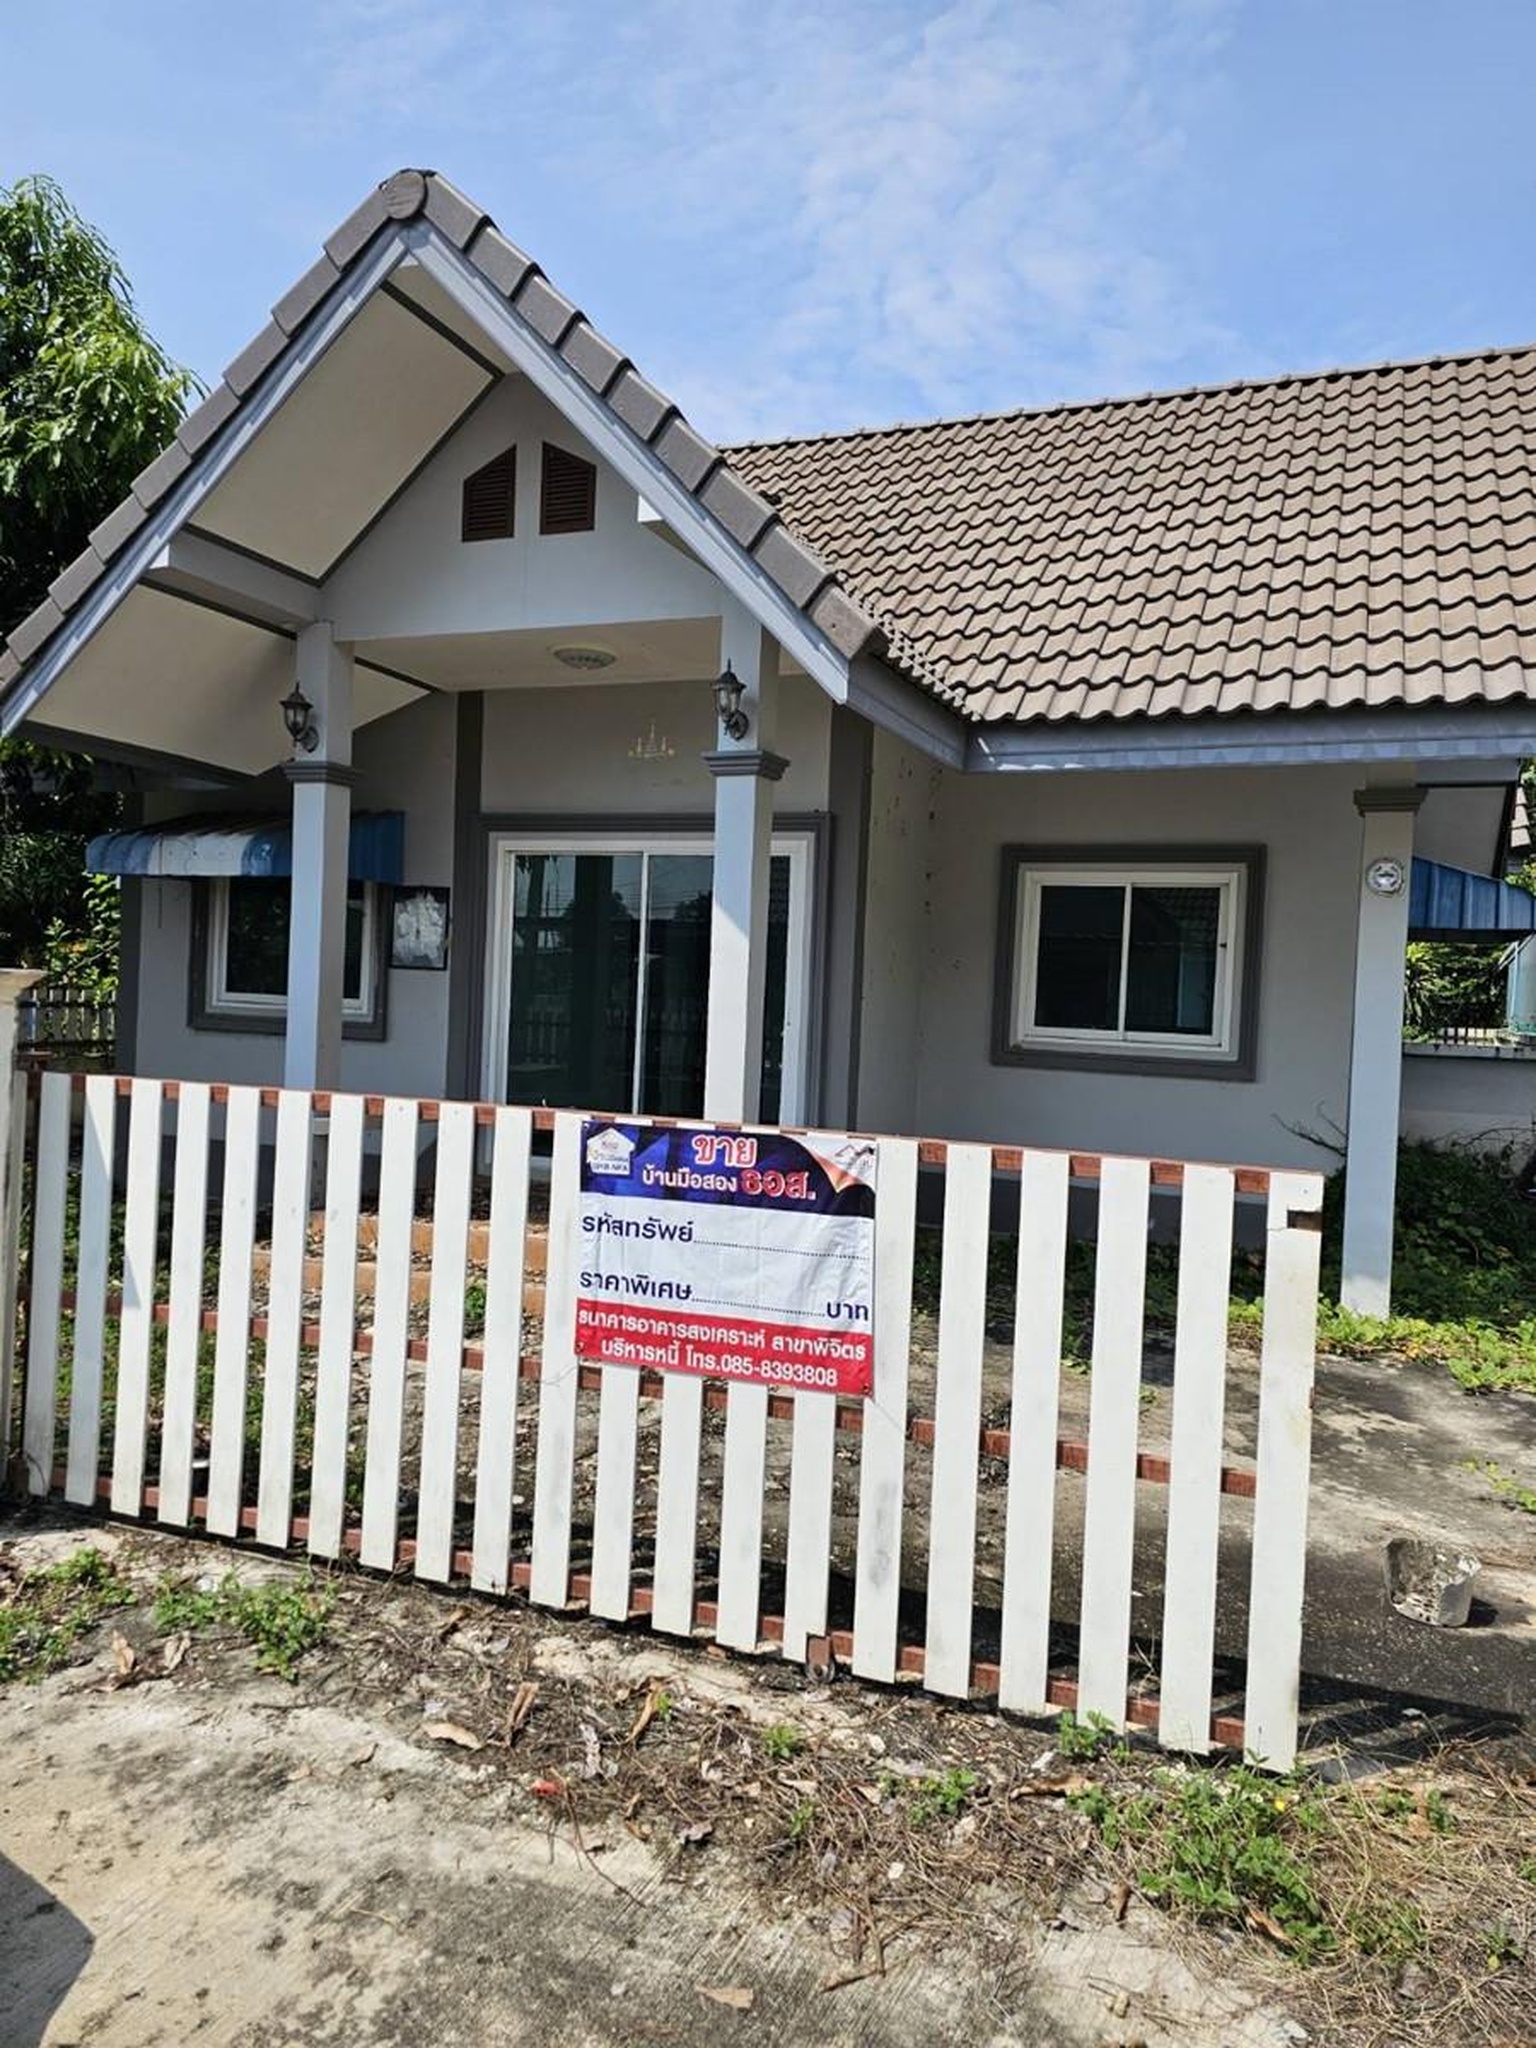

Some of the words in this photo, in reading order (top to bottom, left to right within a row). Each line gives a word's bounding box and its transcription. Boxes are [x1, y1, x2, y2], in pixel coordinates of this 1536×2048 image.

[693, 1134, 757, 1167] ขาย
[643, 1165, 737, 1191] บ้านมือสอง
[826, 1301, 869, 1321] บาท
[578, 1310, 765, 1349] ธนาคารอาคารสงเคราะห์
[772, 1334, 866, 1361] สาขาพิจิตร
[601, 1337, 680, 1365] บริหารหนี้
